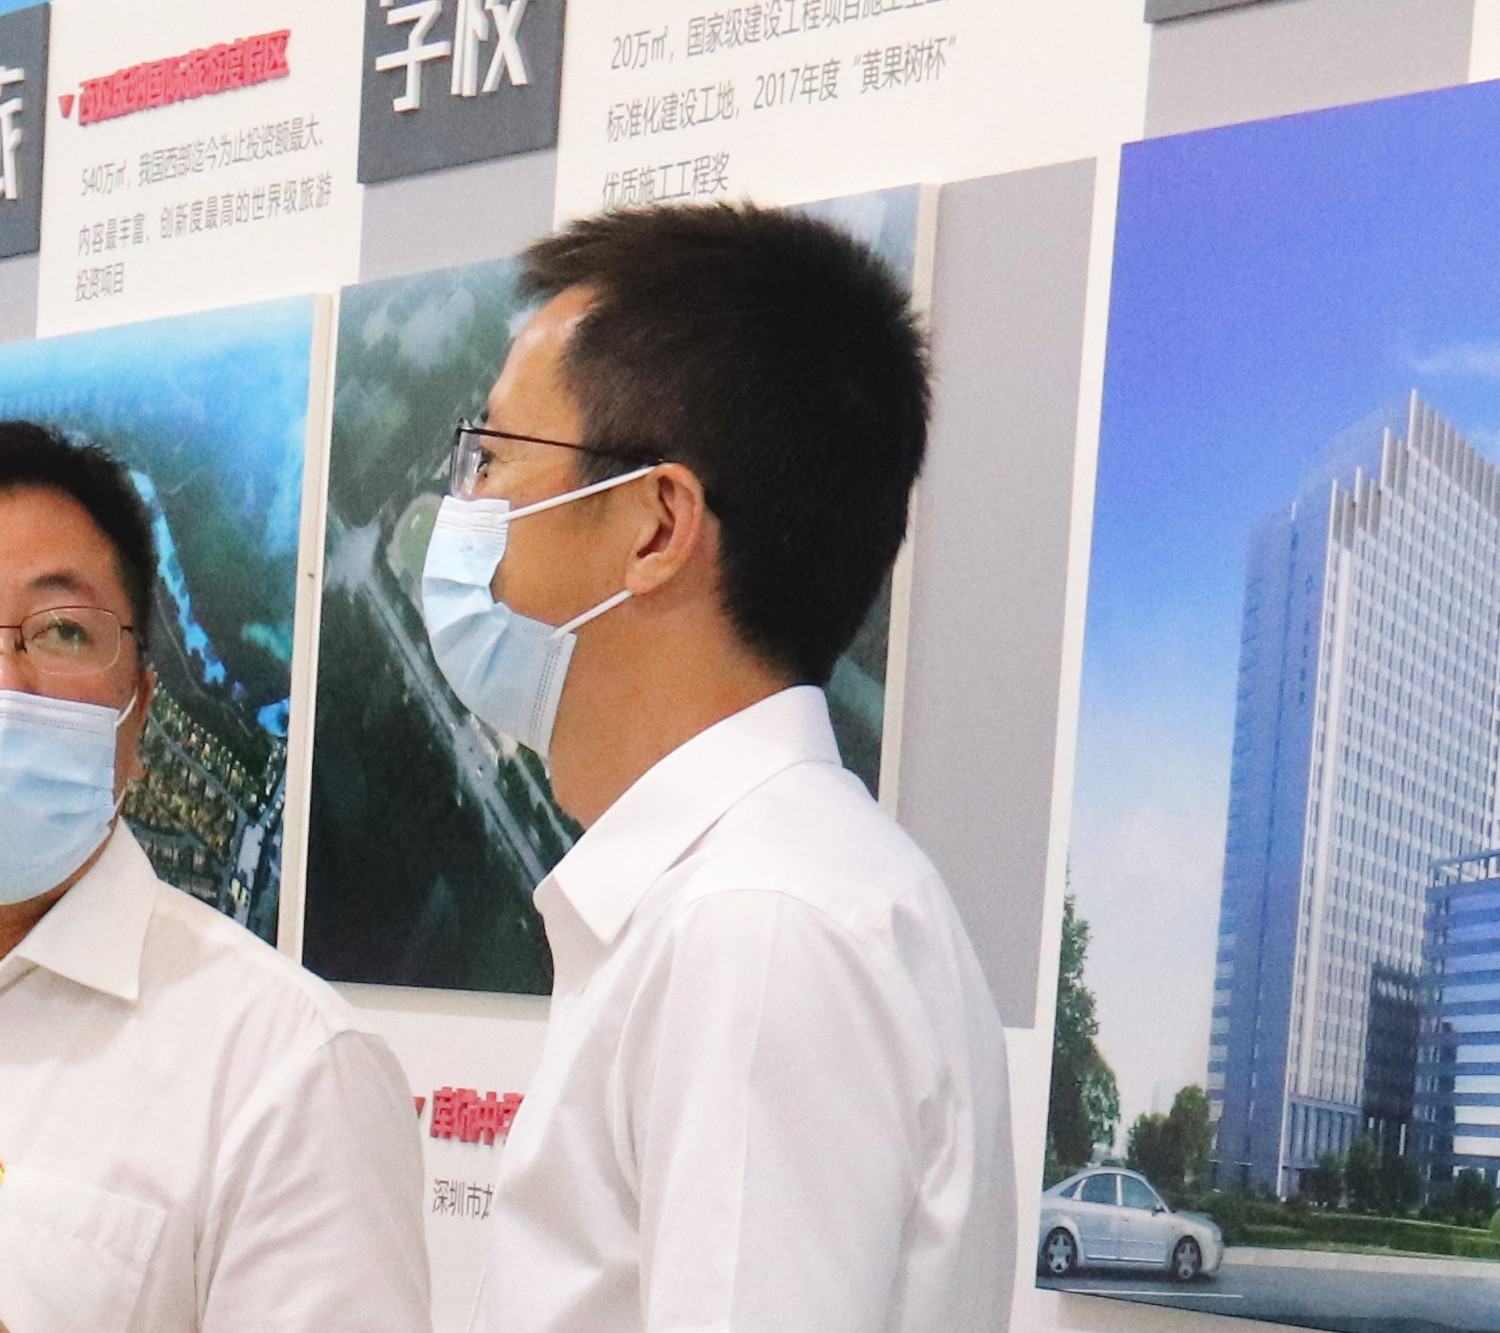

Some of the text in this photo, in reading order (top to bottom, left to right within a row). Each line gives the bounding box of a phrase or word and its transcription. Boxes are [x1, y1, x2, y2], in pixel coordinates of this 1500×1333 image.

[602, 152, 731, 209] 优质施工工程奖
[75, 262, 125, 302] 投资项目
